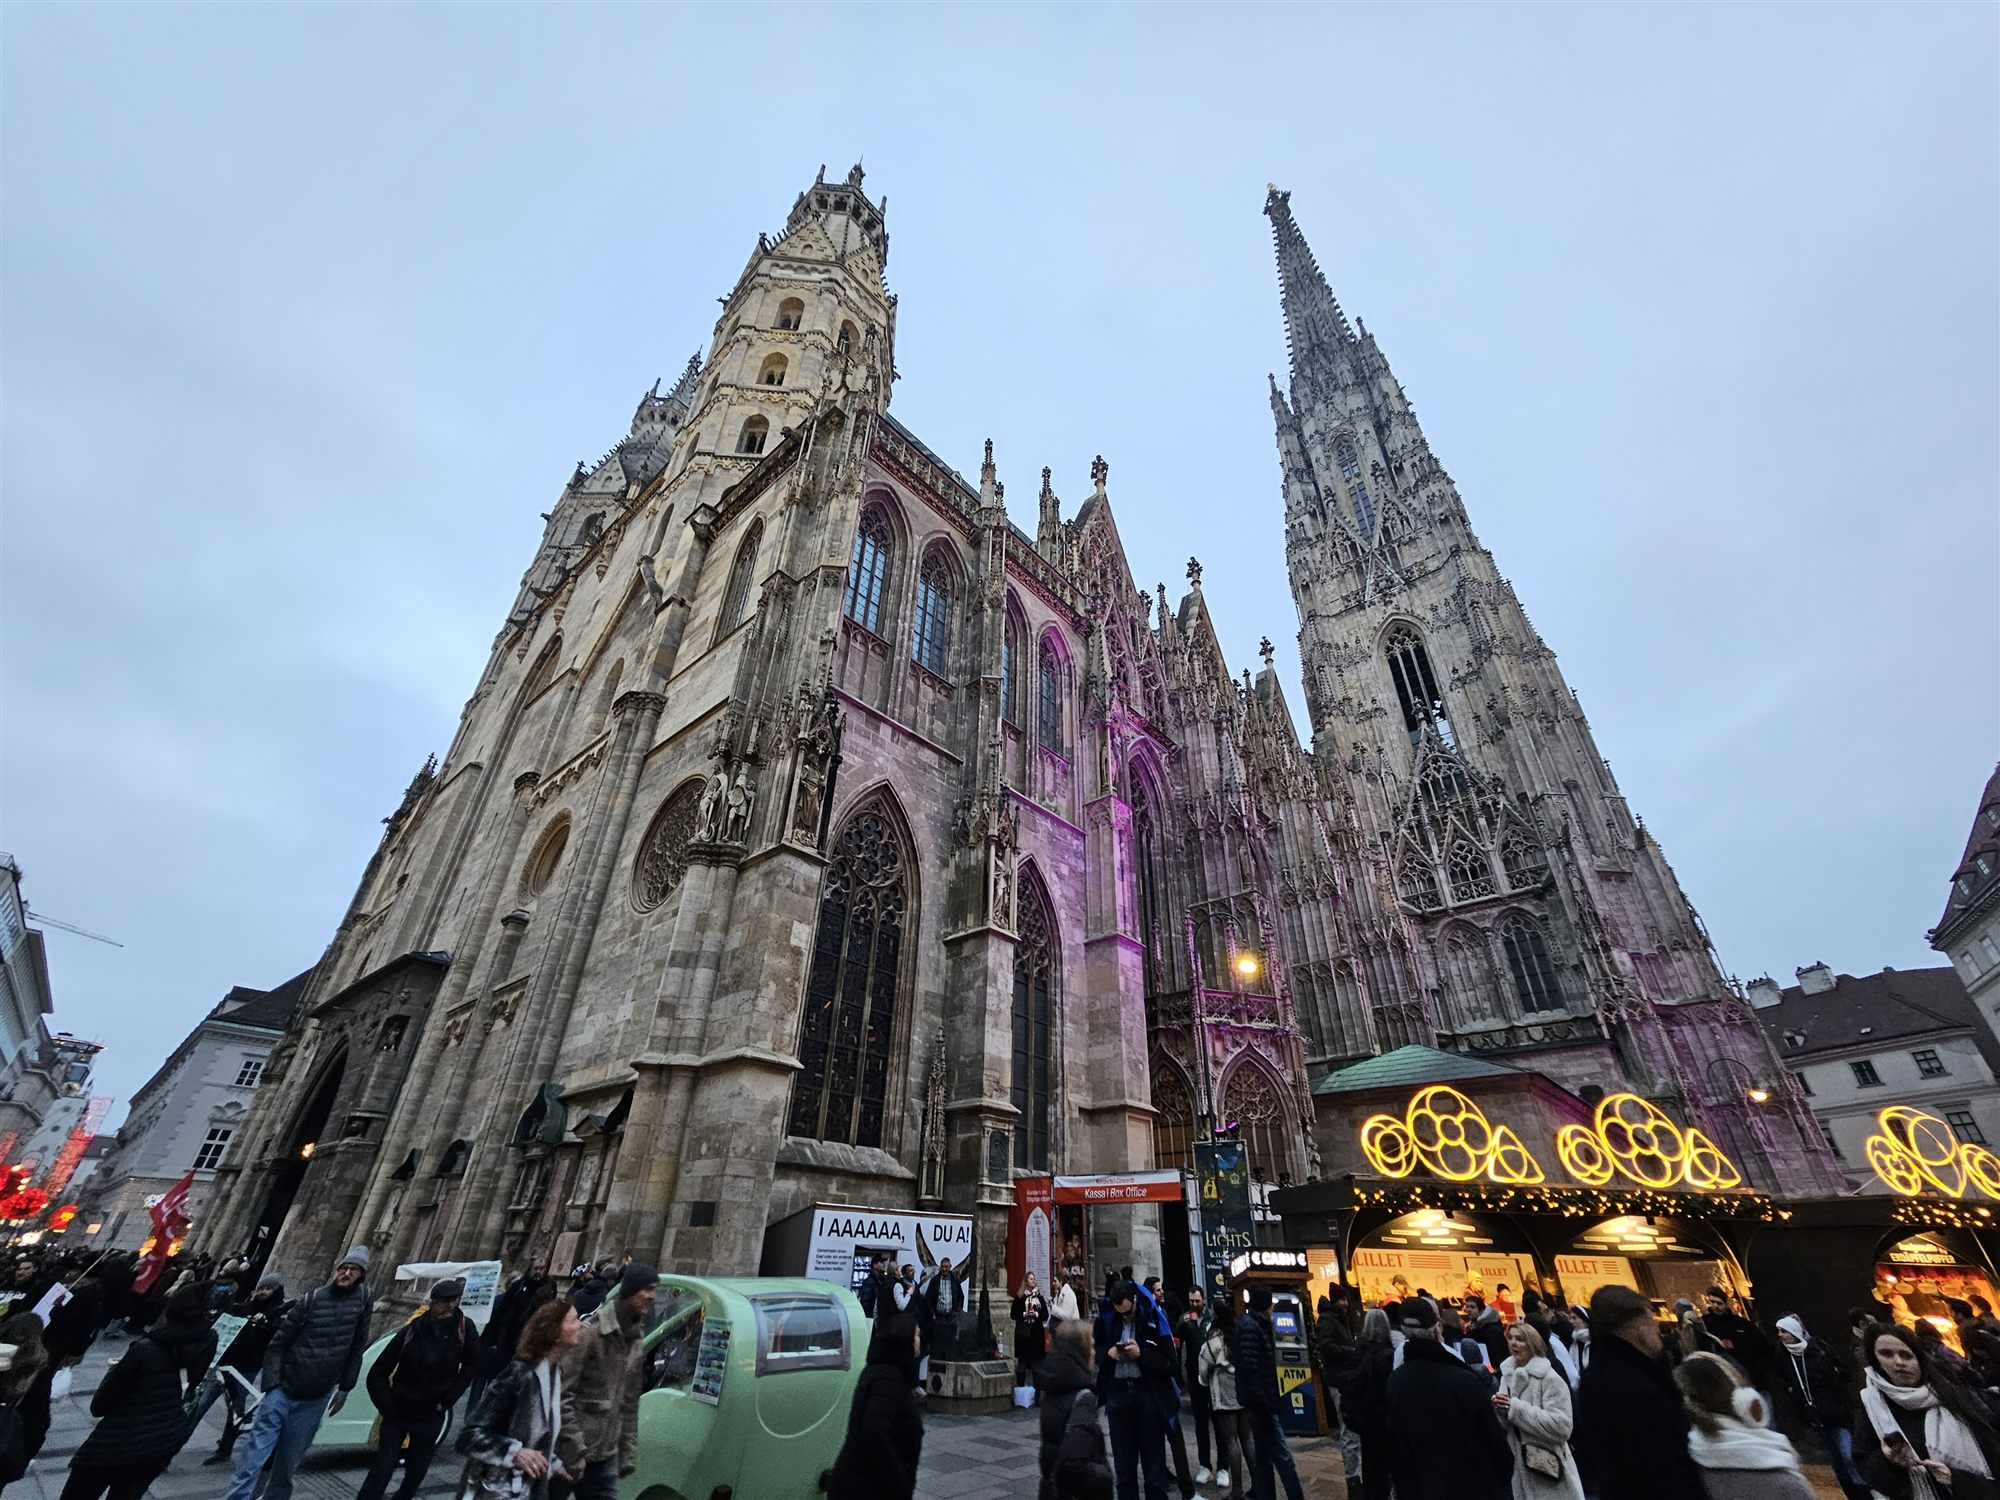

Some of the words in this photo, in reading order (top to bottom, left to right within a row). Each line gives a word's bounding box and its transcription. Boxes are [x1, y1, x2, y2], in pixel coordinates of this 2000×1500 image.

[1084, 1190, 1105, 1199] Kassa
[1110, 1188, 1124, 1198] Box
[1125, 1186, 1147, 1197] Office
[827, 1218, 905, 1243] AAAAAA,
[933, 1224, 952, 1242] DU
[956, 1227, 970, 1243] A!
[1262, 1251, 1296, 1266] CASH
[1355, 1253, 1404, 1268] LILLET
[1480, 1267, 1508, 1277] LILLET
[1556, 1259, 1599, 1274] ILLET
[1276, 1317, 1294, 1327] ATM
[1283, 1368, 1307, 1380] ATM
